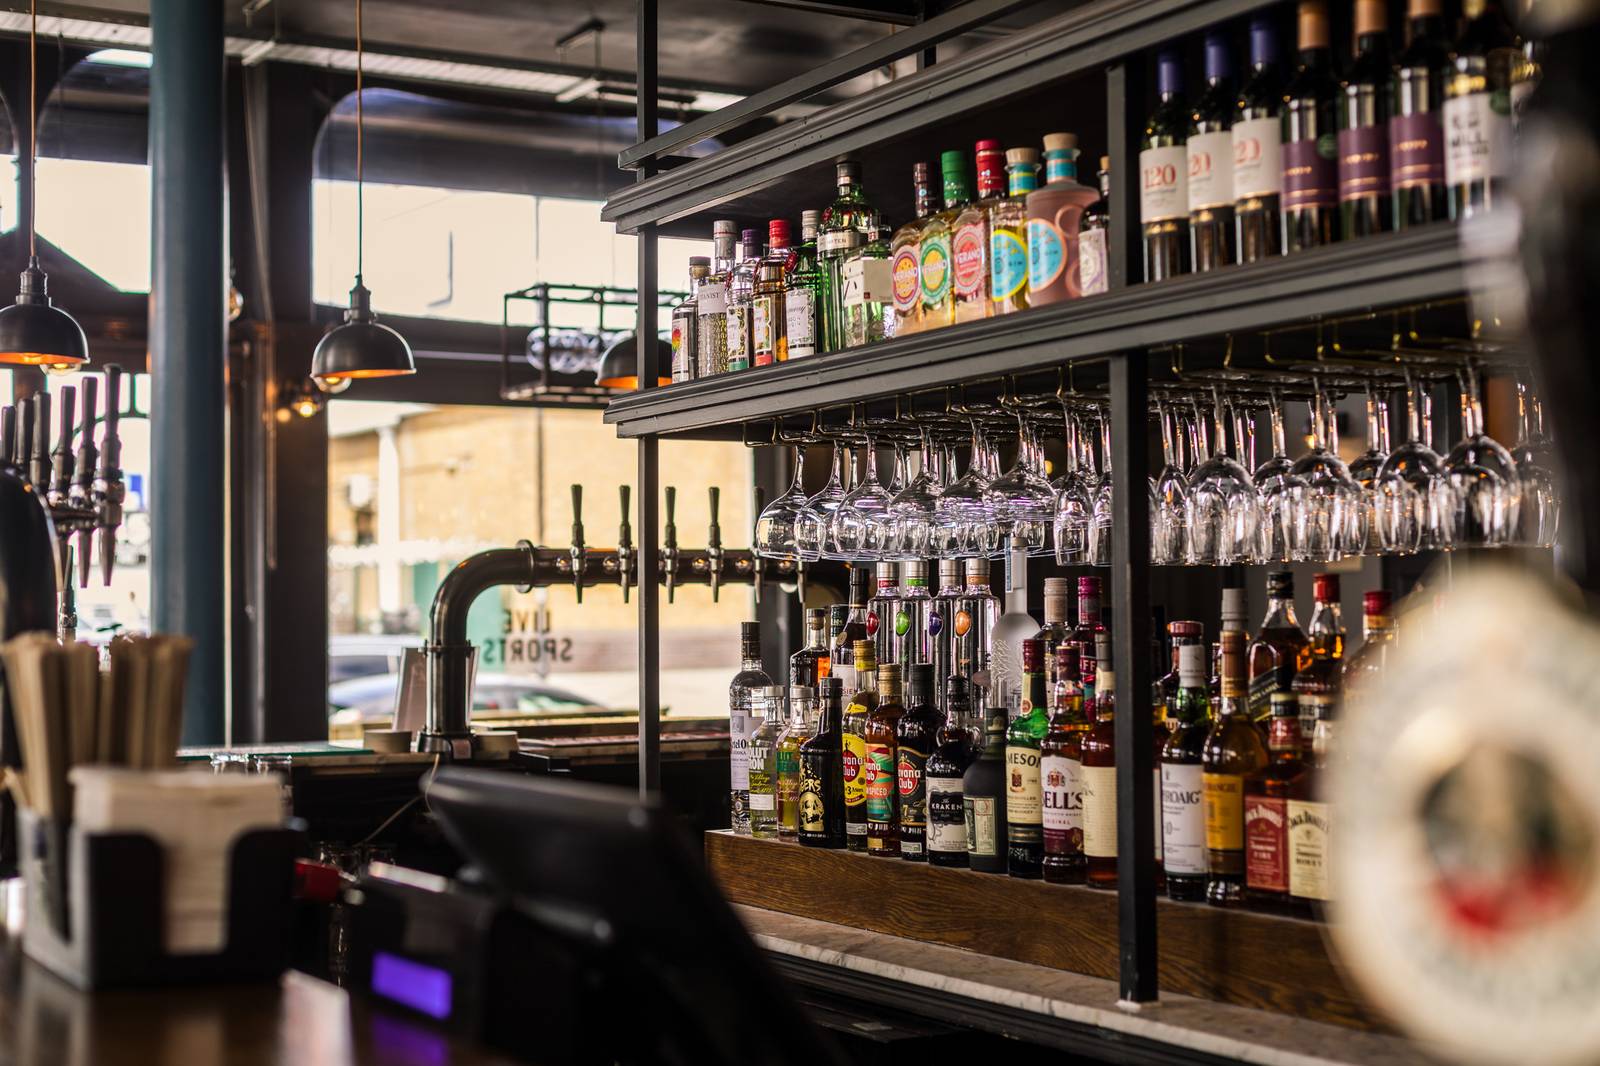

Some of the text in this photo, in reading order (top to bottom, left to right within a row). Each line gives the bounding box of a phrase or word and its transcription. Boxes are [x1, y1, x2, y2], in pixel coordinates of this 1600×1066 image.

[1233, 138, 1261, 163] 20
[1144, 163, 1176, 189] 120
[1188, 153, 1211, 177] 20
[1042, 791, 1083, 810] ELL'S
